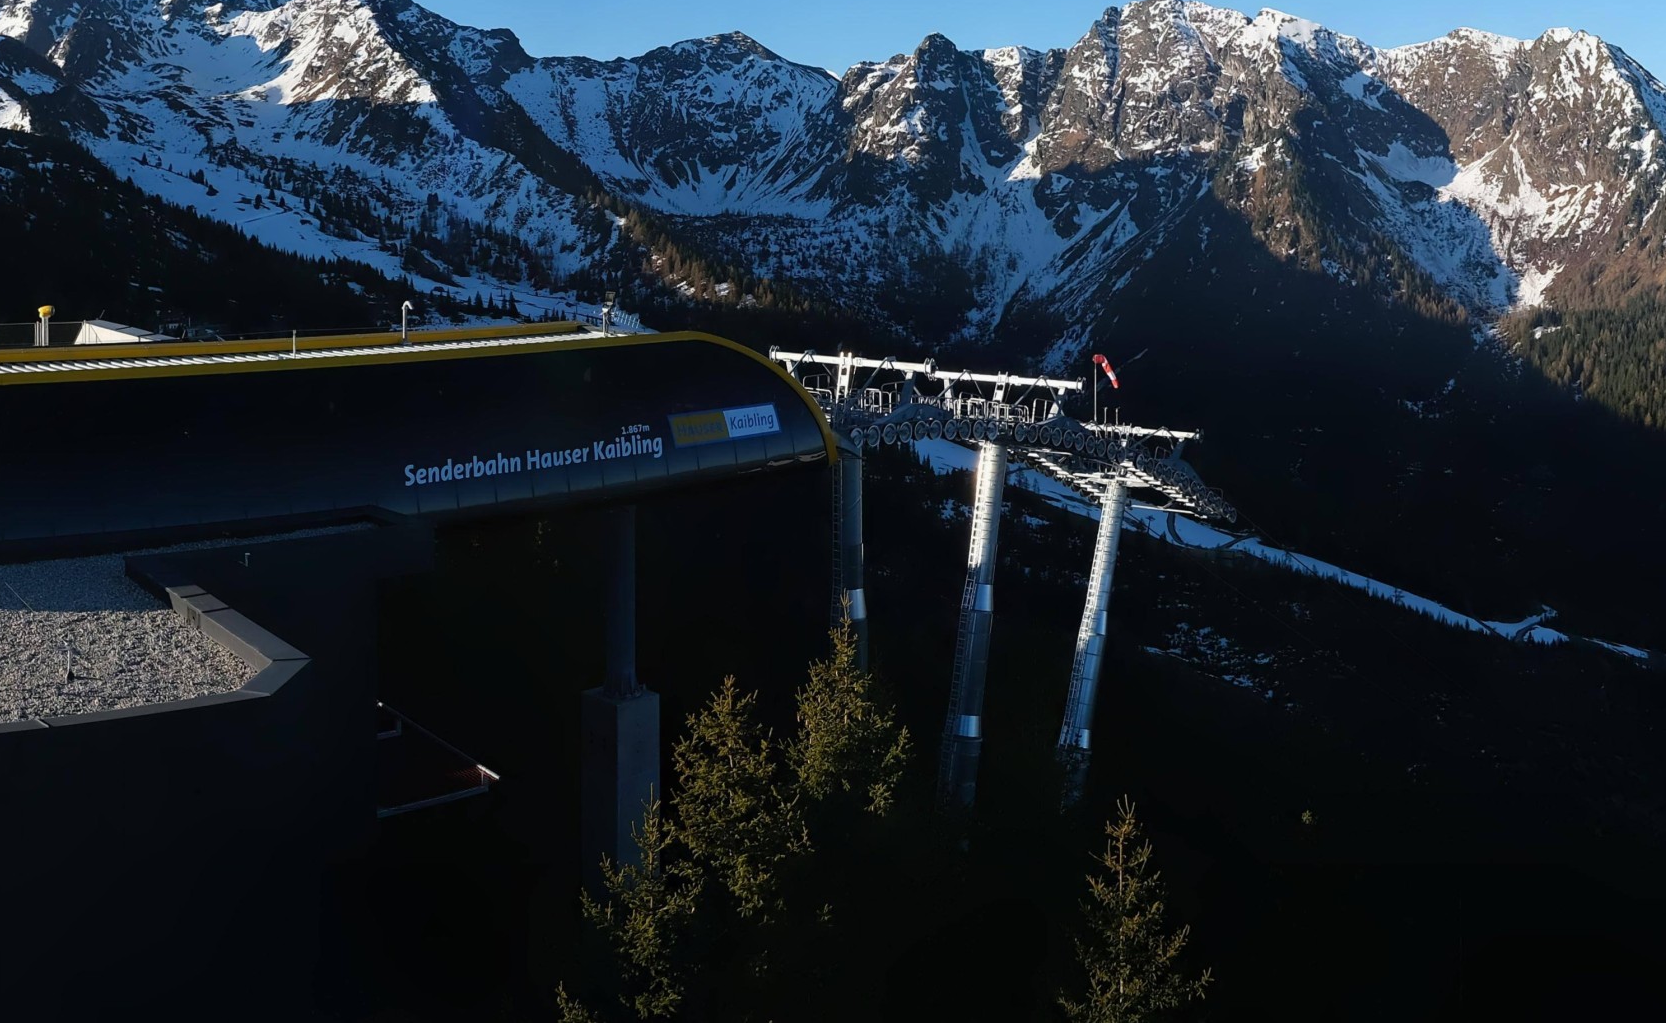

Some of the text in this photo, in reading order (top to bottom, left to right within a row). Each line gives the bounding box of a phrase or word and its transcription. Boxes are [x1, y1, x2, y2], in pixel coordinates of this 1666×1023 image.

[621, 424, 650, 435] 1.867m
[730, 413, 774, 430] Kaibling
[404, 433, 663, 487] Senderbahn Hauser Kaibling
